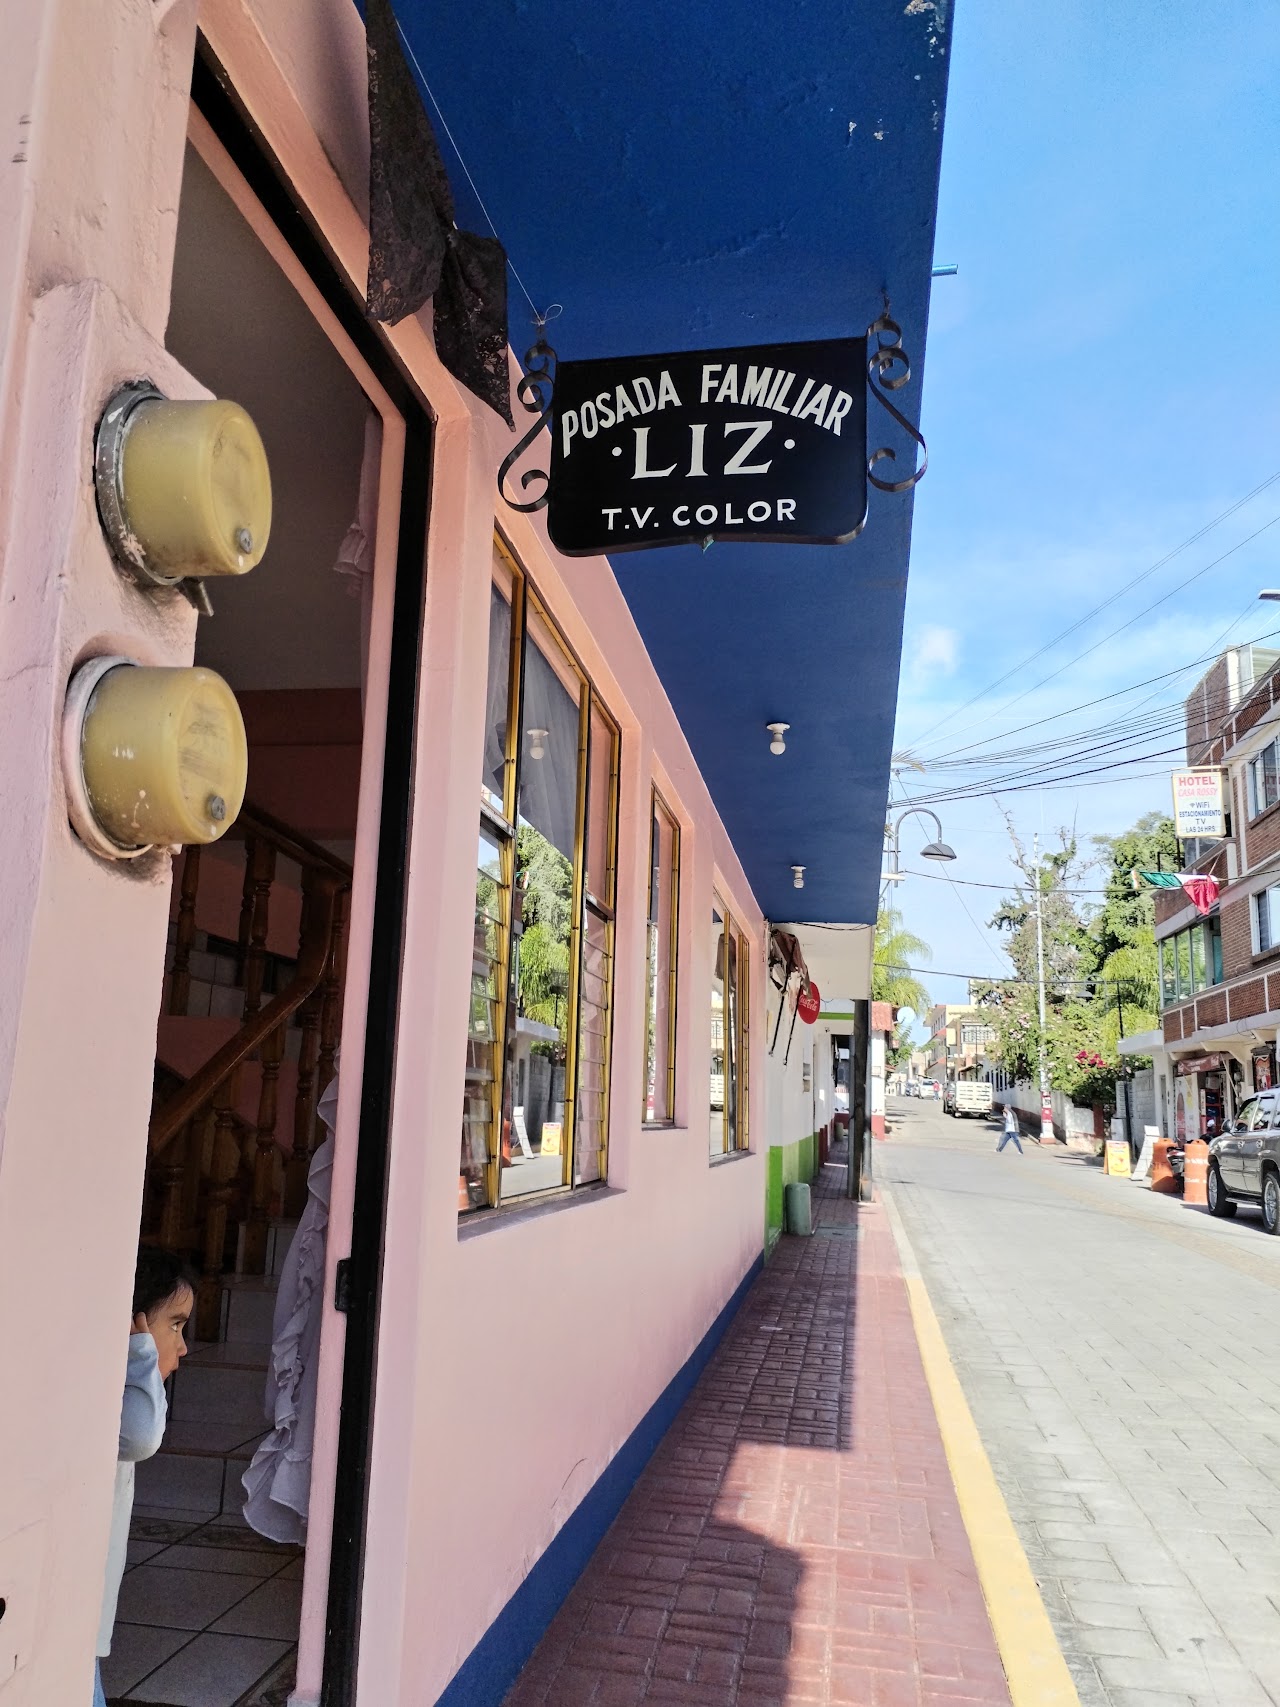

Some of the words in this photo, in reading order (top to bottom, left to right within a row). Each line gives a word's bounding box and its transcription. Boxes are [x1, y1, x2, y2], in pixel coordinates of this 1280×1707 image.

[561, 370, 682, 458] POSADA
[700, 363, 853, 437] FAMILIAR
[630, 420, 773, 480] LIZ
[601, 506, 660, 531] T.V.
[672, 498, 797, 527] COLOR
[1178, 776, 1215, 787] HOTEL
[1179, 809, 1222, 818] ESTACIONAMIENTO
